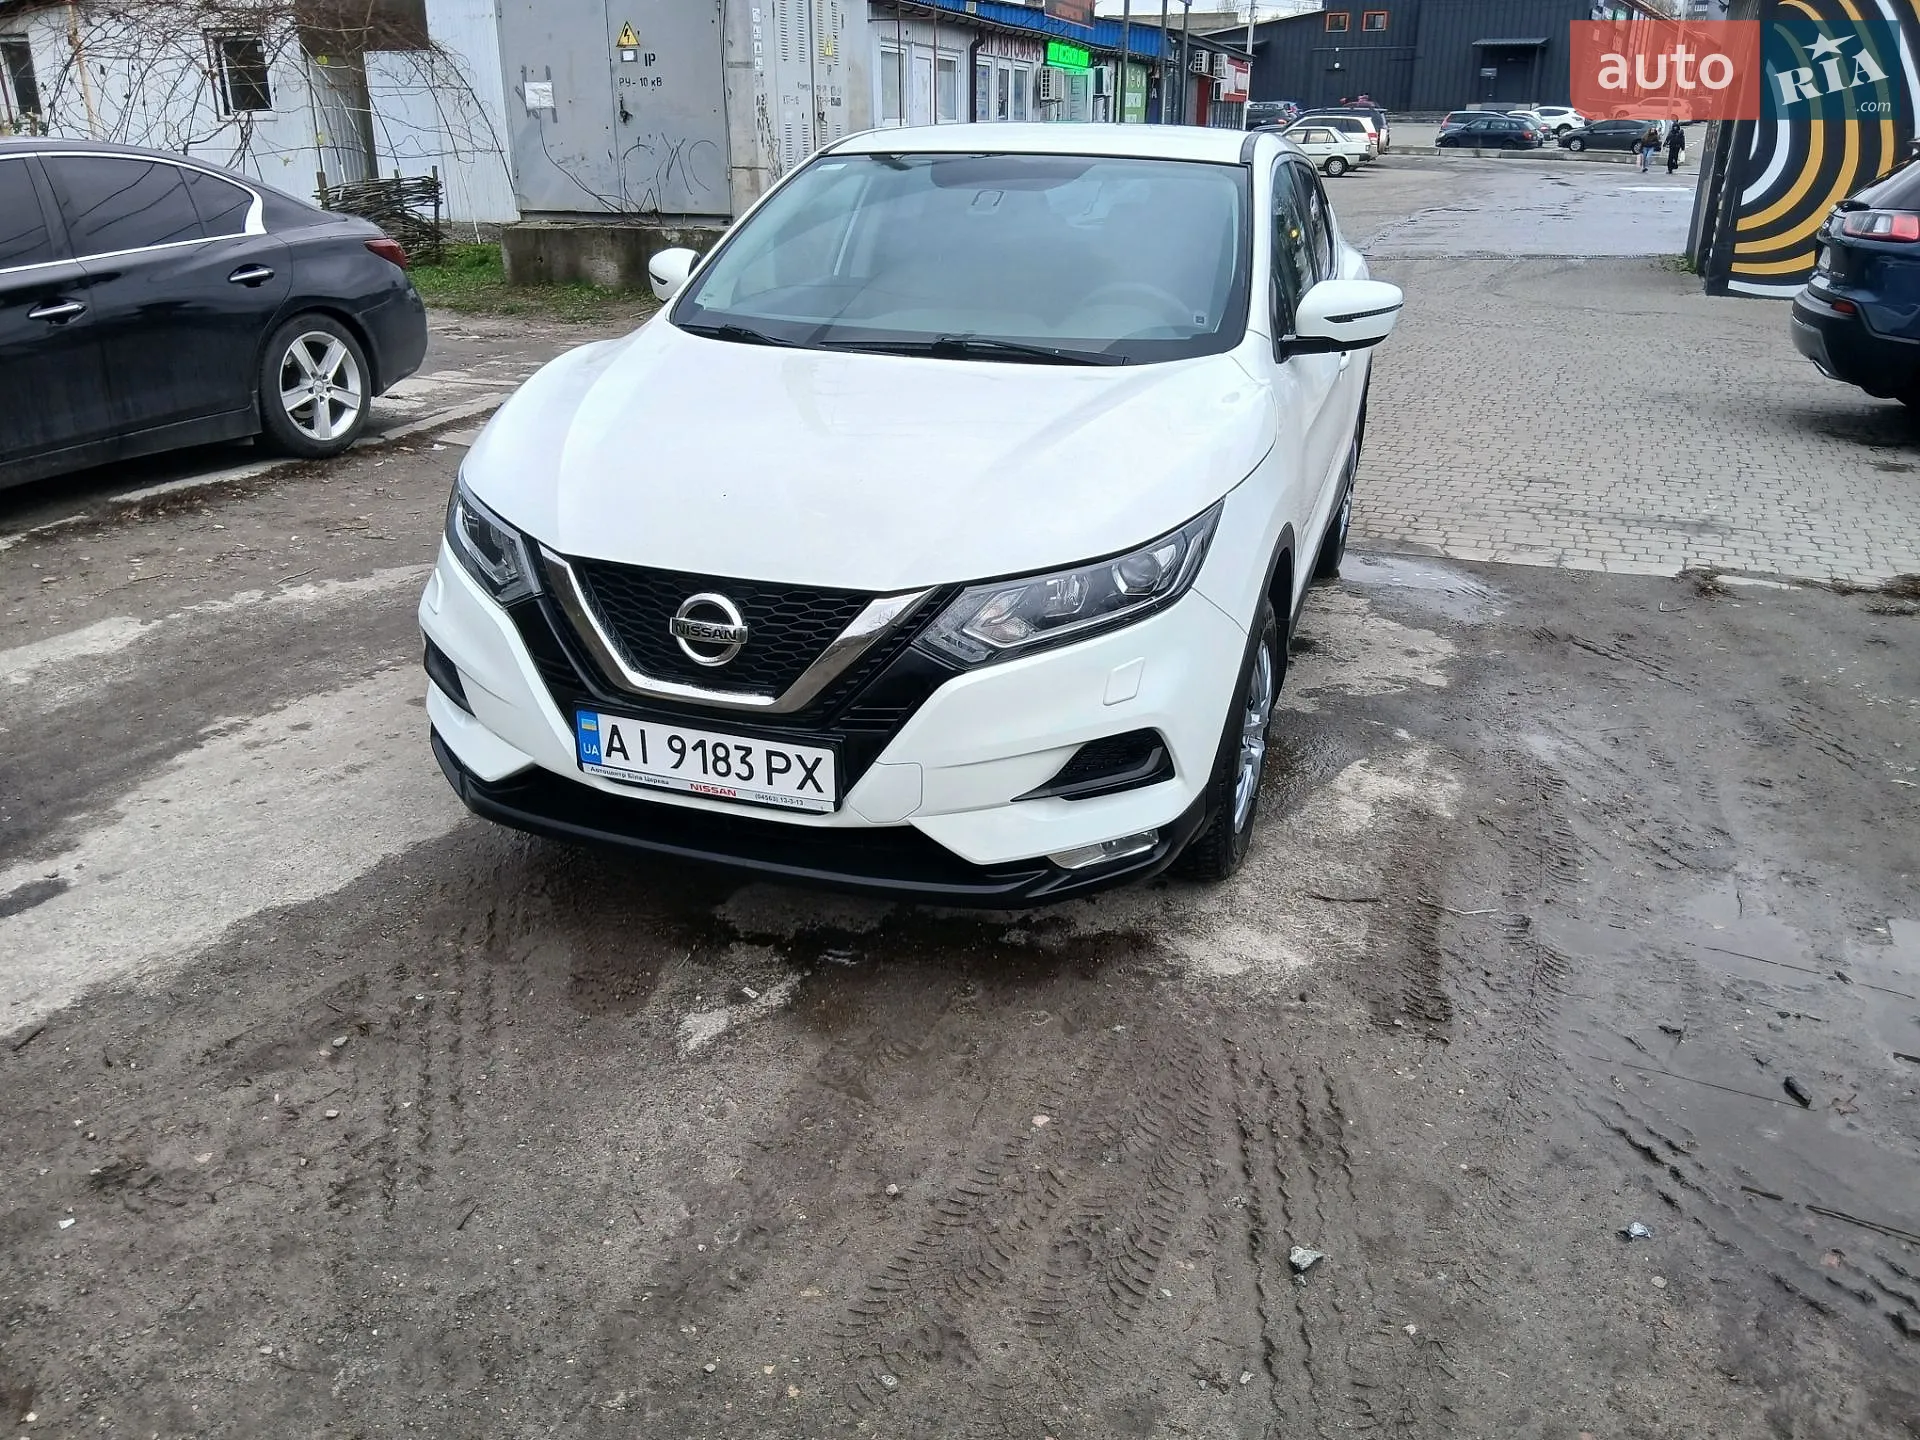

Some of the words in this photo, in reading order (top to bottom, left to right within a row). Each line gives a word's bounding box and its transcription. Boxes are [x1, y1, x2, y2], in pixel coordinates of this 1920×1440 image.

[675, 622, 737, 641] NISSAN
[583, 742, 599, 756] UA
[605, 724, 648, 765] AI
[667, 734, 755, 782] 9183
[765, 749, 825, 794] PX
[690, 783, 737, 797] NISSAN
